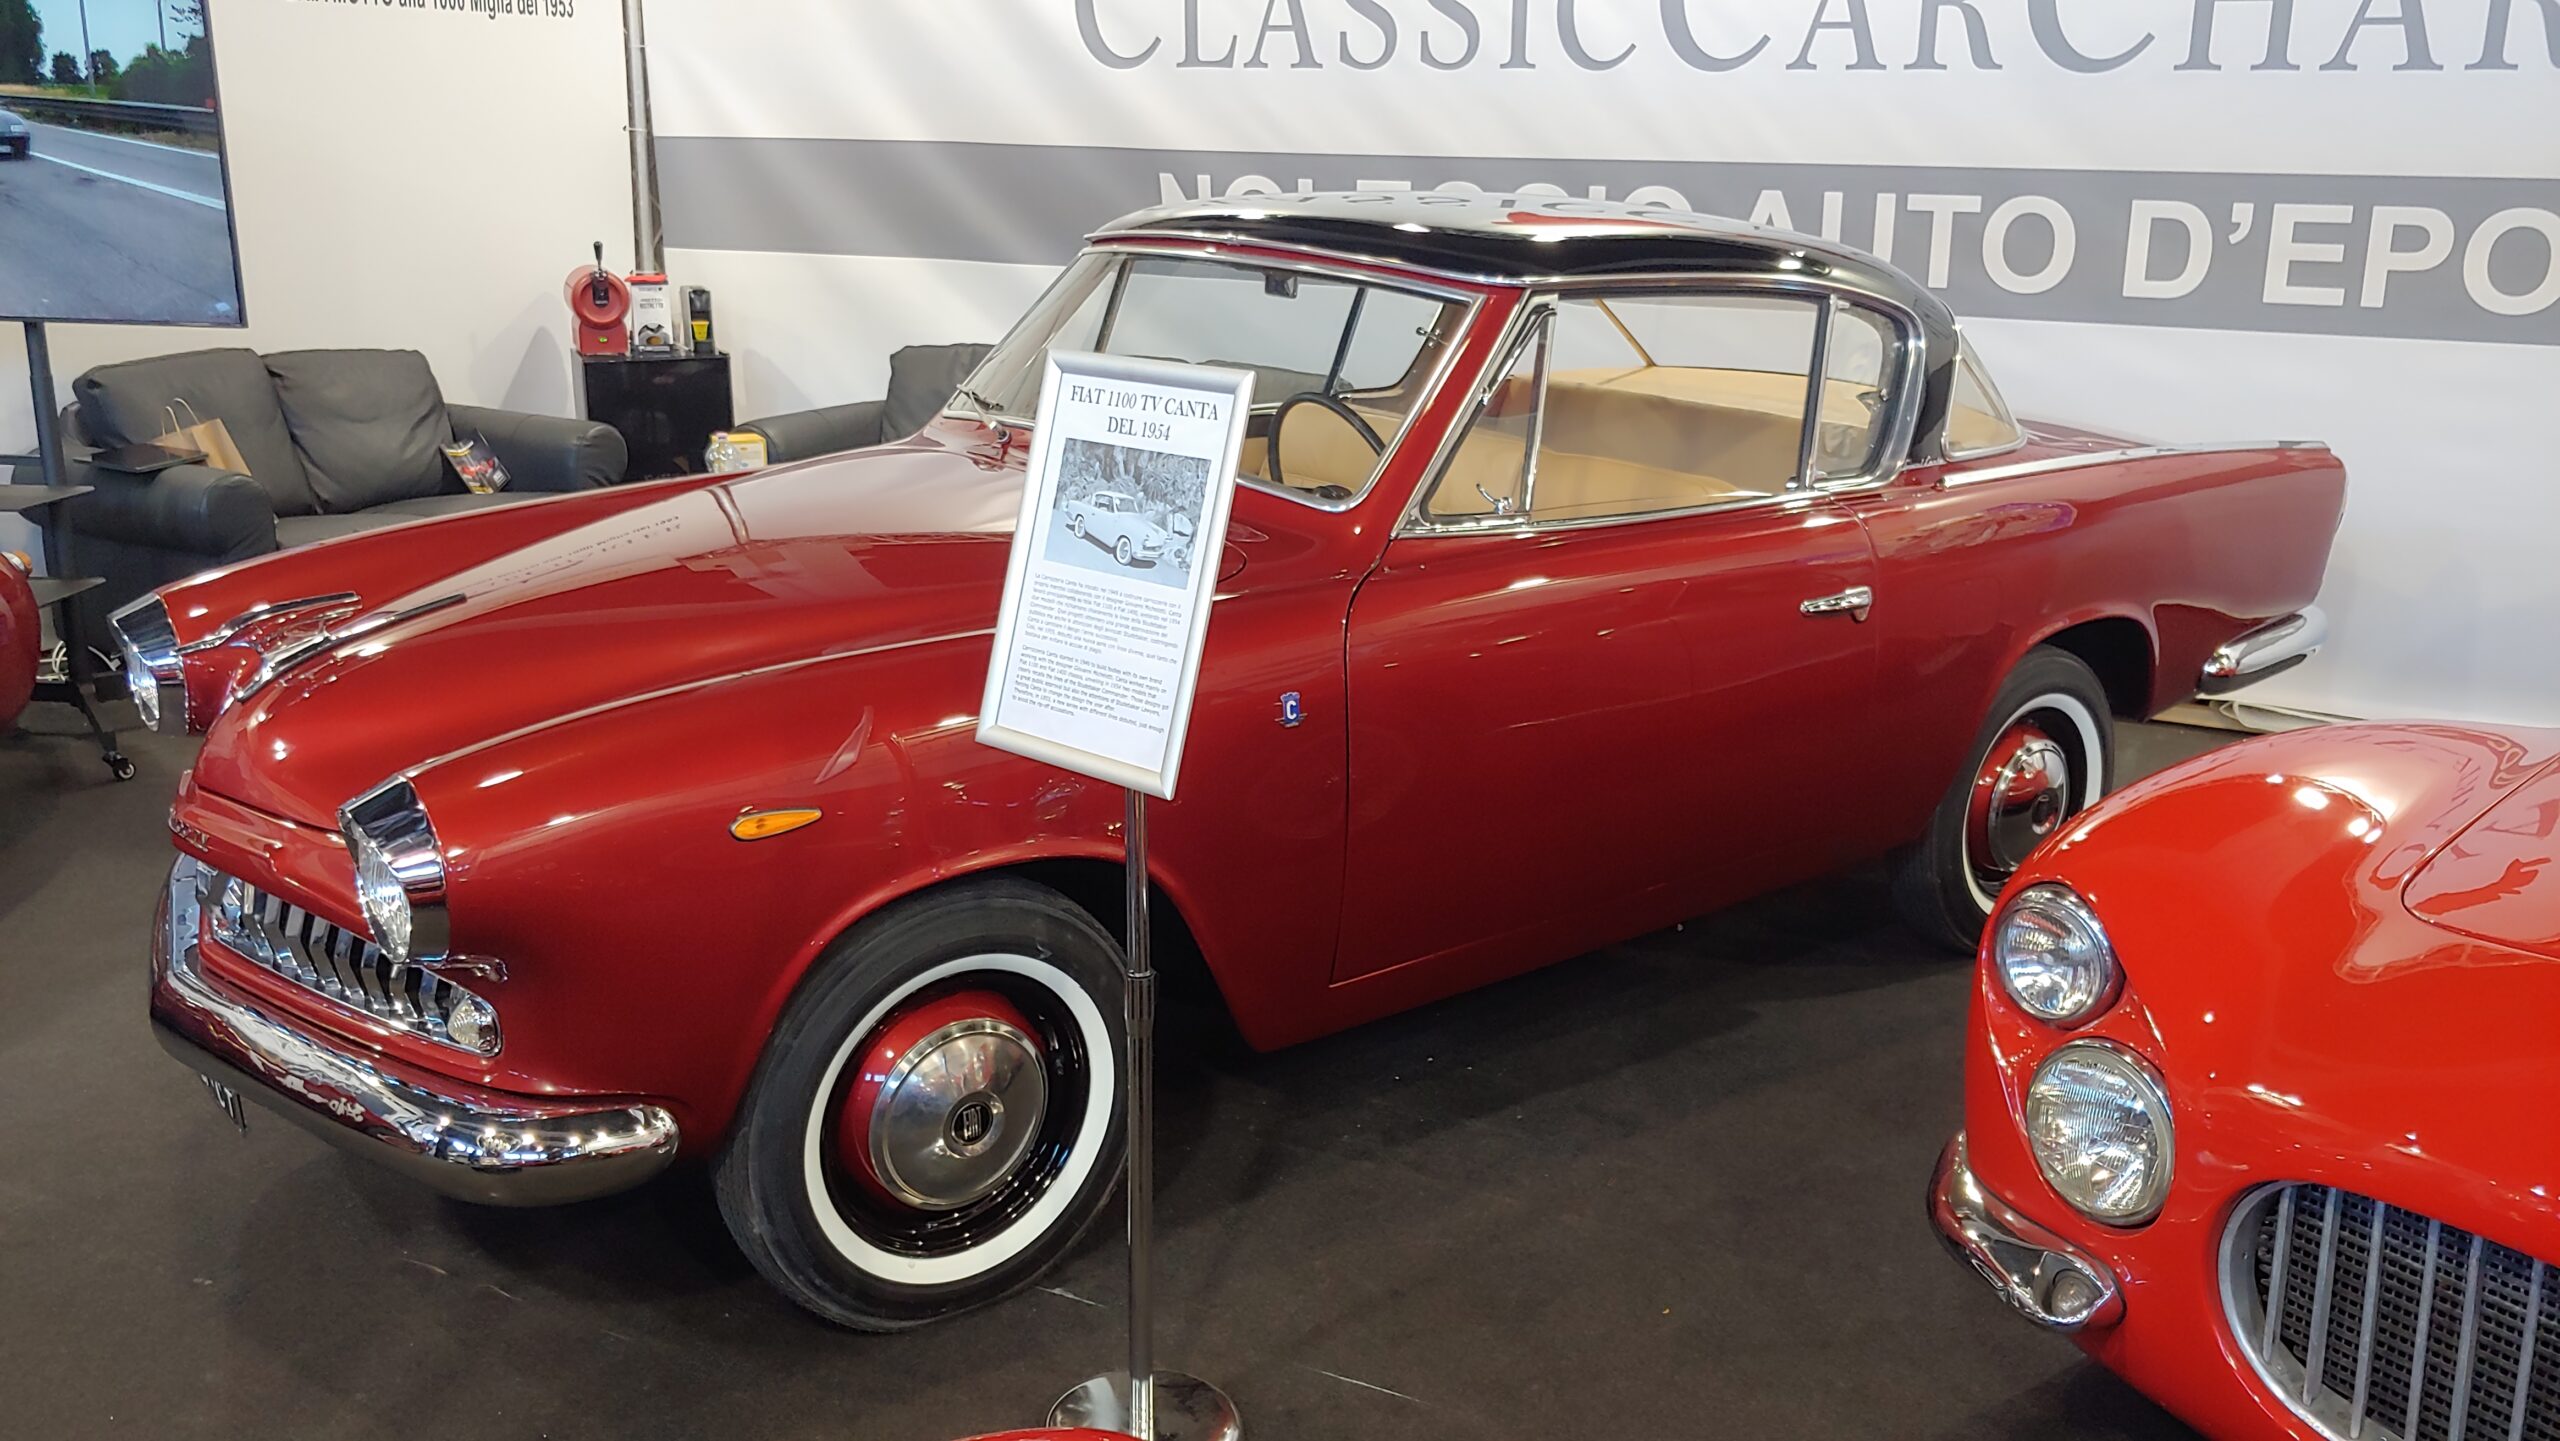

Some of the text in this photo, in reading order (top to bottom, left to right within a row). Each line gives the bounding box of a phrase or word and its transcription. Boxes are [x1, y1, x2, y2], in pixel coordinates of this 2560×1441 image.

[542, 0, 574, 18] 1953
[1070, 385, 1218, 421] FIAT 1100 TV CANTA
[1107, 416, 1171, 441] DEL 1954
[1285, 700, 1297, 720] C
